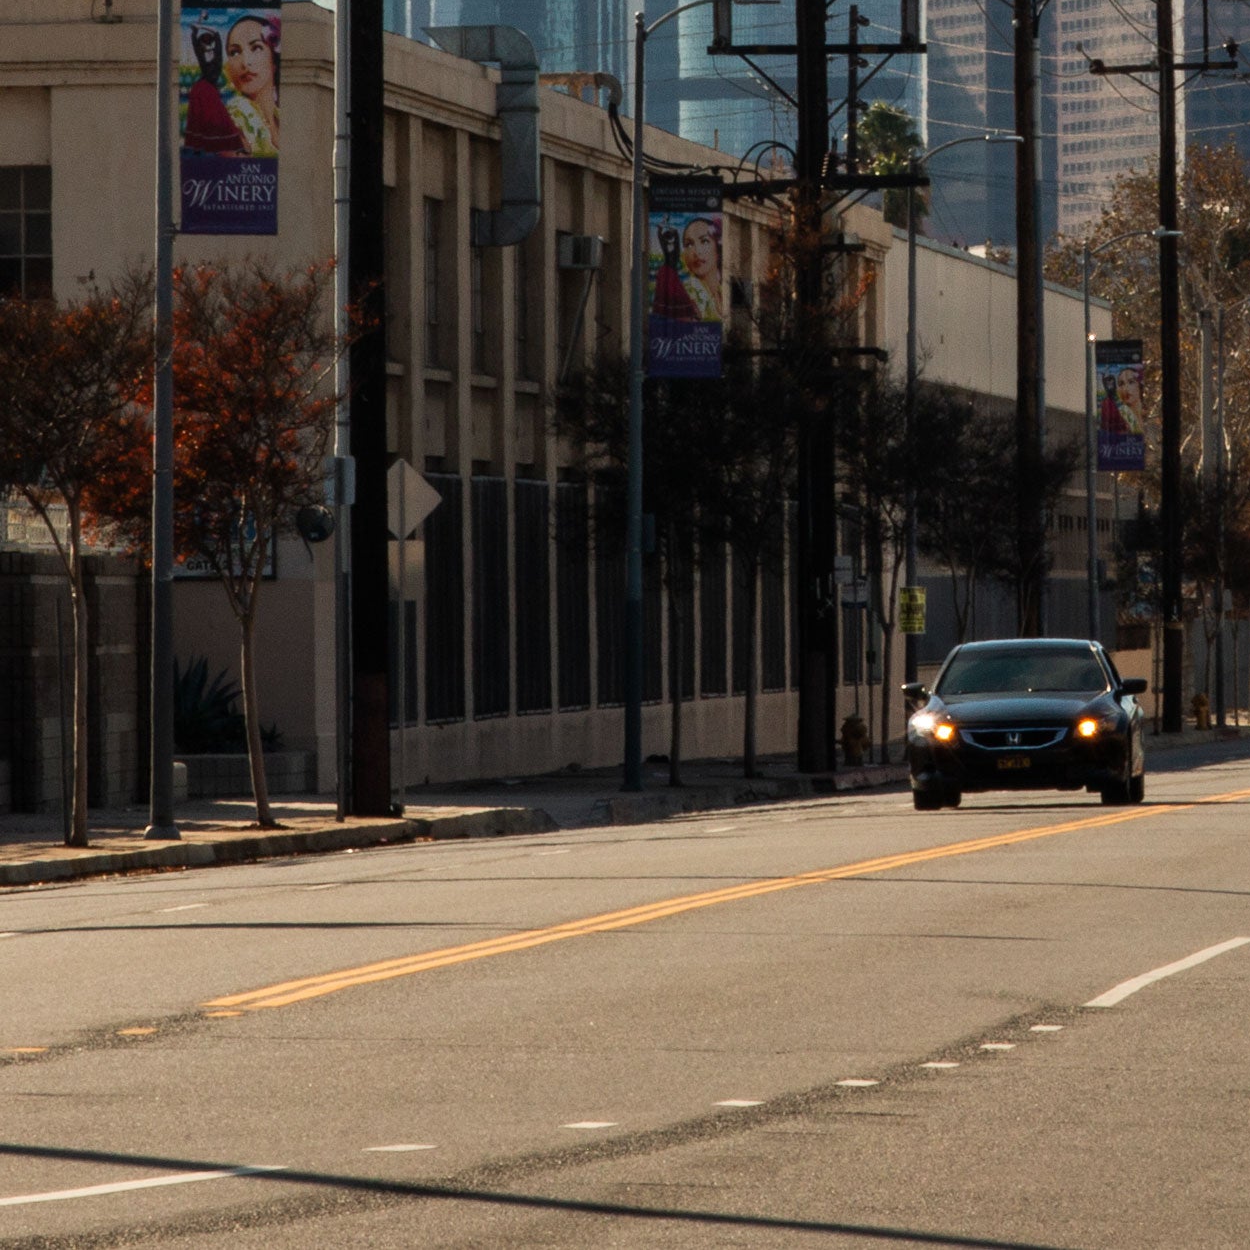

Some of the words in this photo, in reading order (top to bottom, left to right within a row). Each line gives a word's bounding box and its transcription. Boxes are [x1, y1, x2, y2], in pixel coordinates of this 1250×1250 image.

[240, 163, 261, 173] SAN
[226, 174, 276, 184] ANTONIO
[183, 178, 275, 207] WINERY
[651, 337, 720, 358] WINERY
